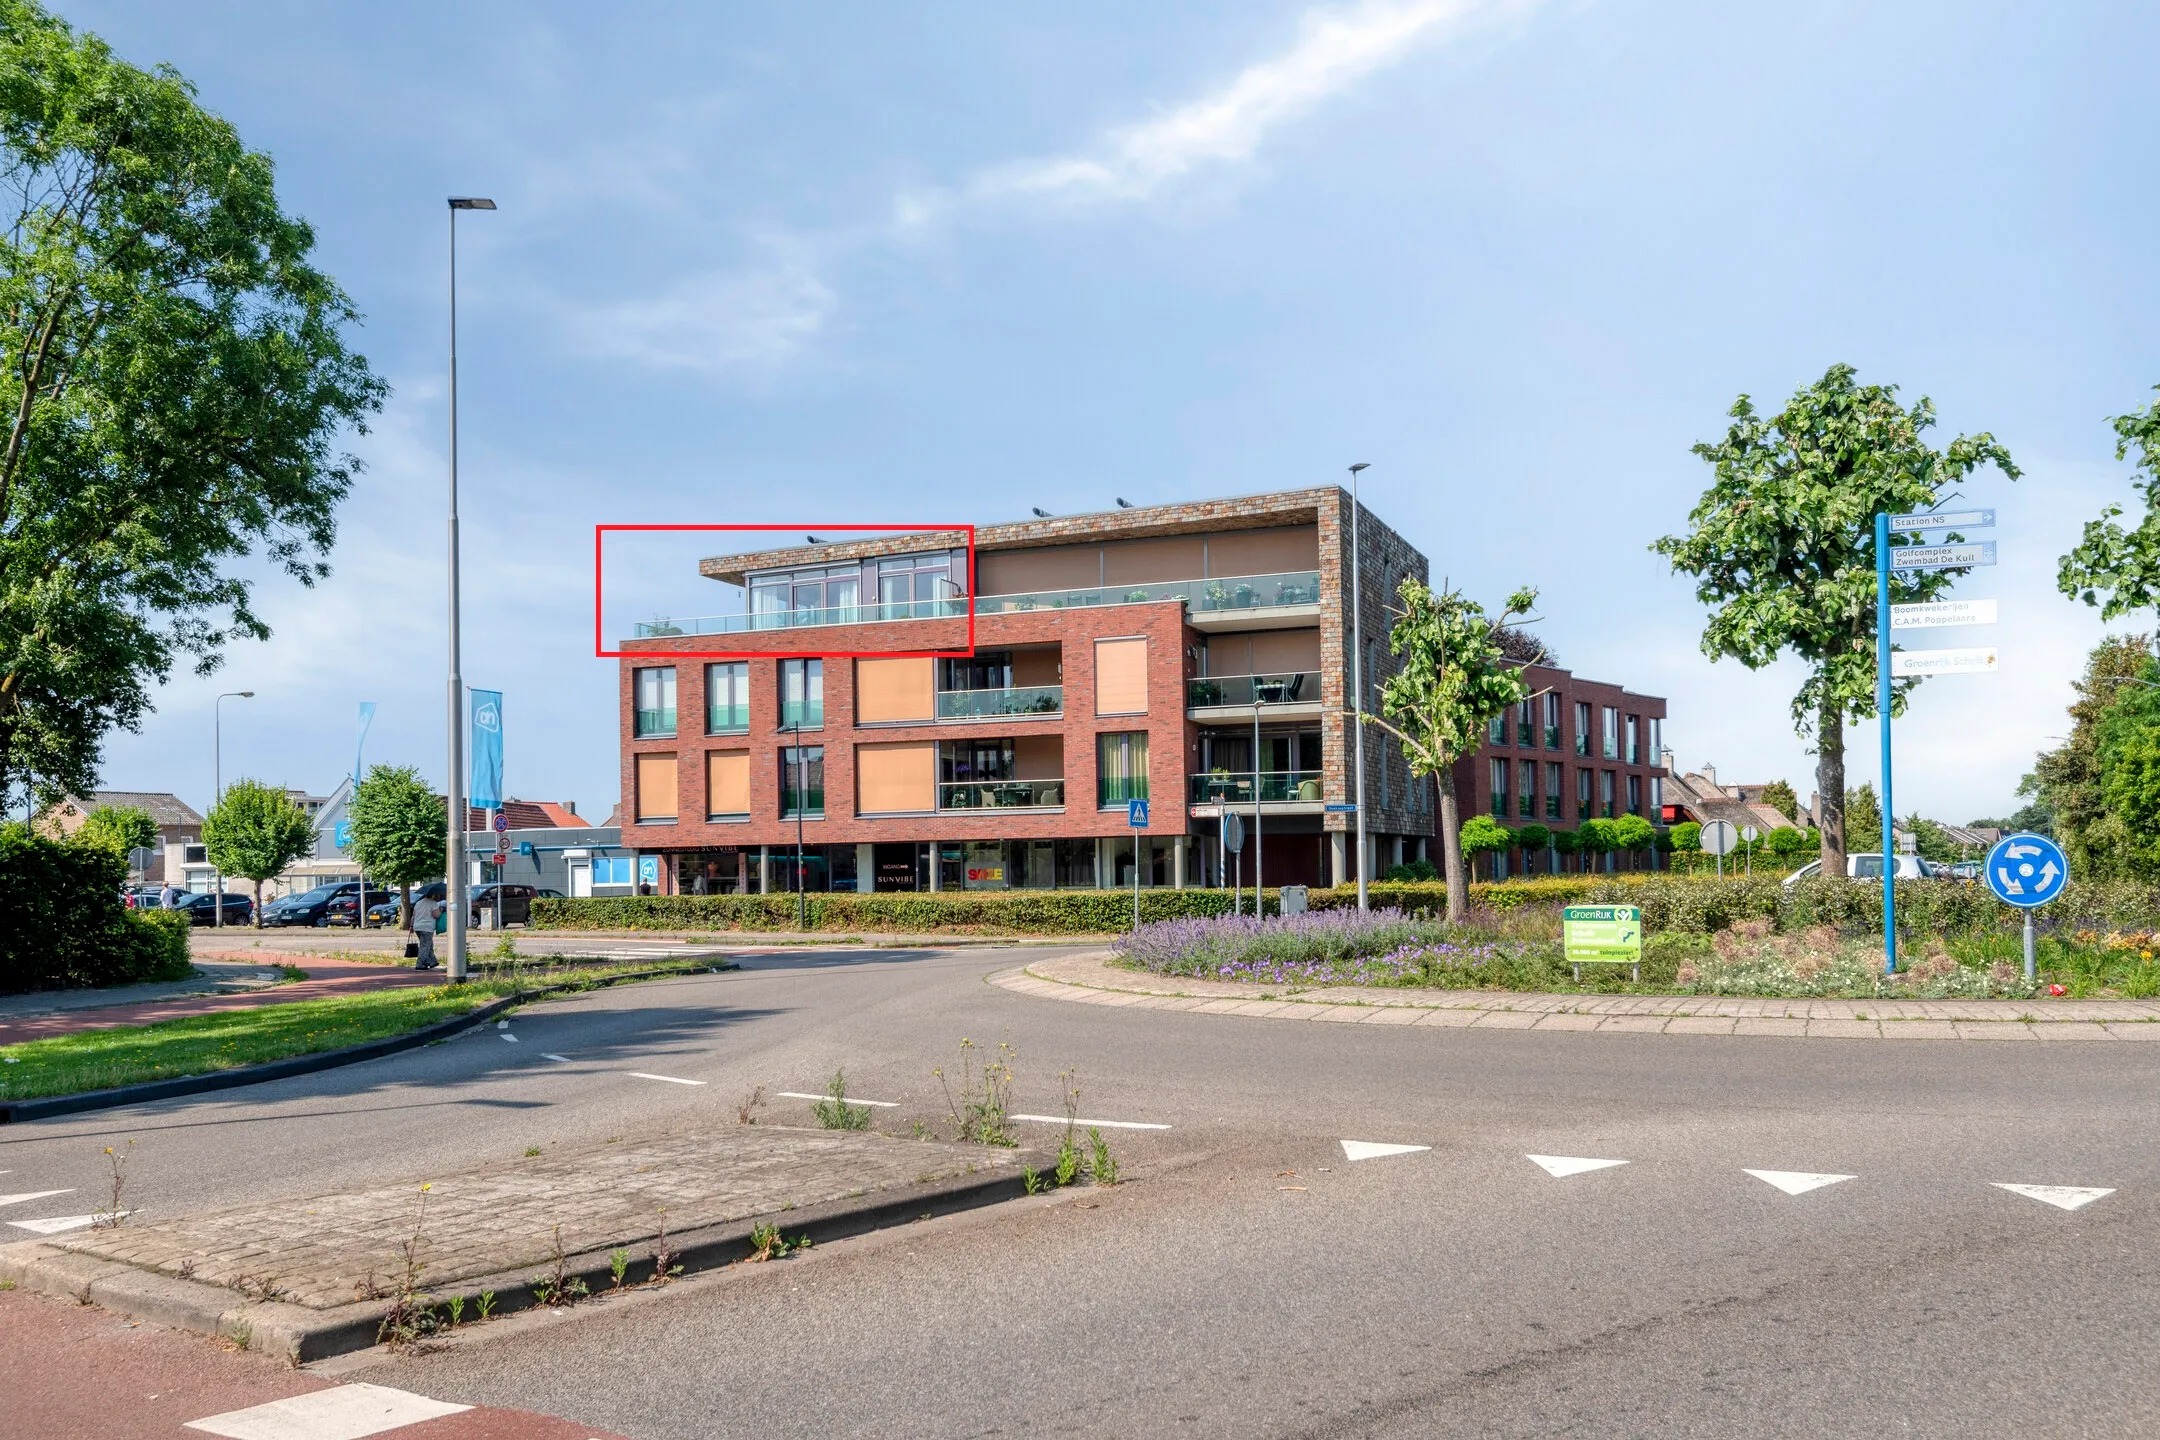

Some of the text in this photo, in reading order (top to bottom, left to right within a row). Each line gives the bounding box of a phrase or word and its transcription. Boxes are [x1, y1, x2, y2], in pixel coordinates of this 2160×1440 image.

[1895, 516, 1945, 526] Station NS
[1895, 548, 1952, 558] Golfcomplex
[1896, 554, 1975, 566] Zwembad De Kuil
[1894, 603, 1969, 614] Boomkwekerijen
[1894, 615, 1976, 626] C.A.M. Poppelaars
